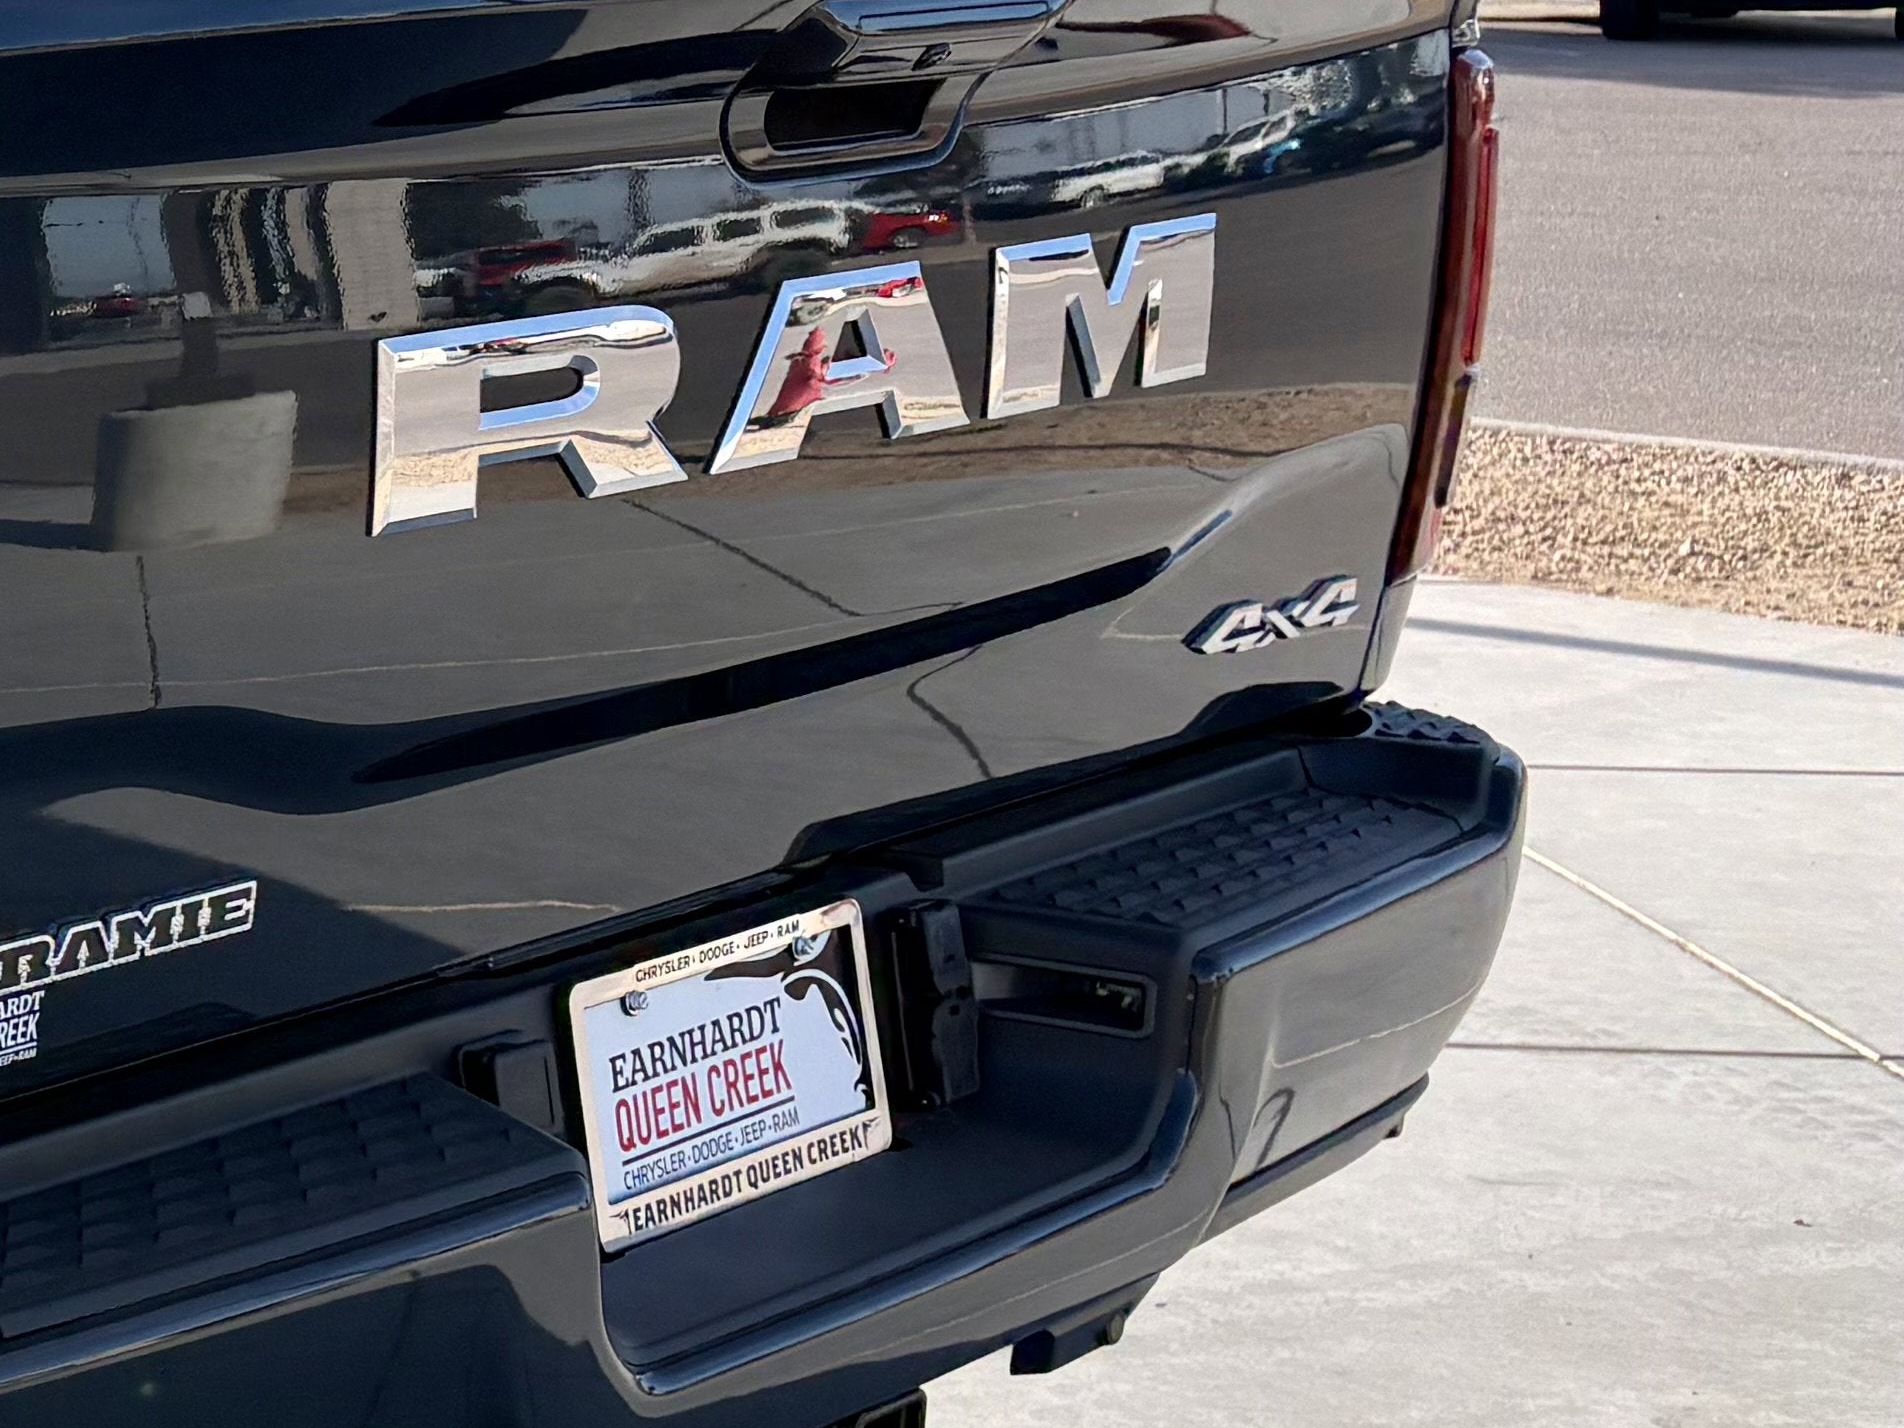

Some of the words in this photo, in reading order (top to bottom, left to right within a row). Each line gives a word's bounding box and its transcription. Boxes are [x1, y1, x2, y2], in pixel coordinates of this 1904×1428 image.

[366, 212, 1217, 538] RAM
[635, 956, 691, 983] CHRYSLER
[699, 941, 736, 964] DODGE
[743, 930, 769, 949] JEEP
[776, 919, 800, 938] RAM
[608, 996, 782, 1094] EARNHARDT
[614, 1076, 703, 1154] QUEEN
[706, 1038, 793, 1118] CREEK
[623, 1151, 687, 1191] CHRYSLER
[692, 1131, 734, 1164] DODGE
[740, 1118, 767, 1147] JEEP
[772, 1106, 801, 1133] RAM
[633, 1169, 744, 1232] EARNHARDT
[746, 1144, 804, 1190] QUEEN
[807, 1126, 863, 1167] CREEK
